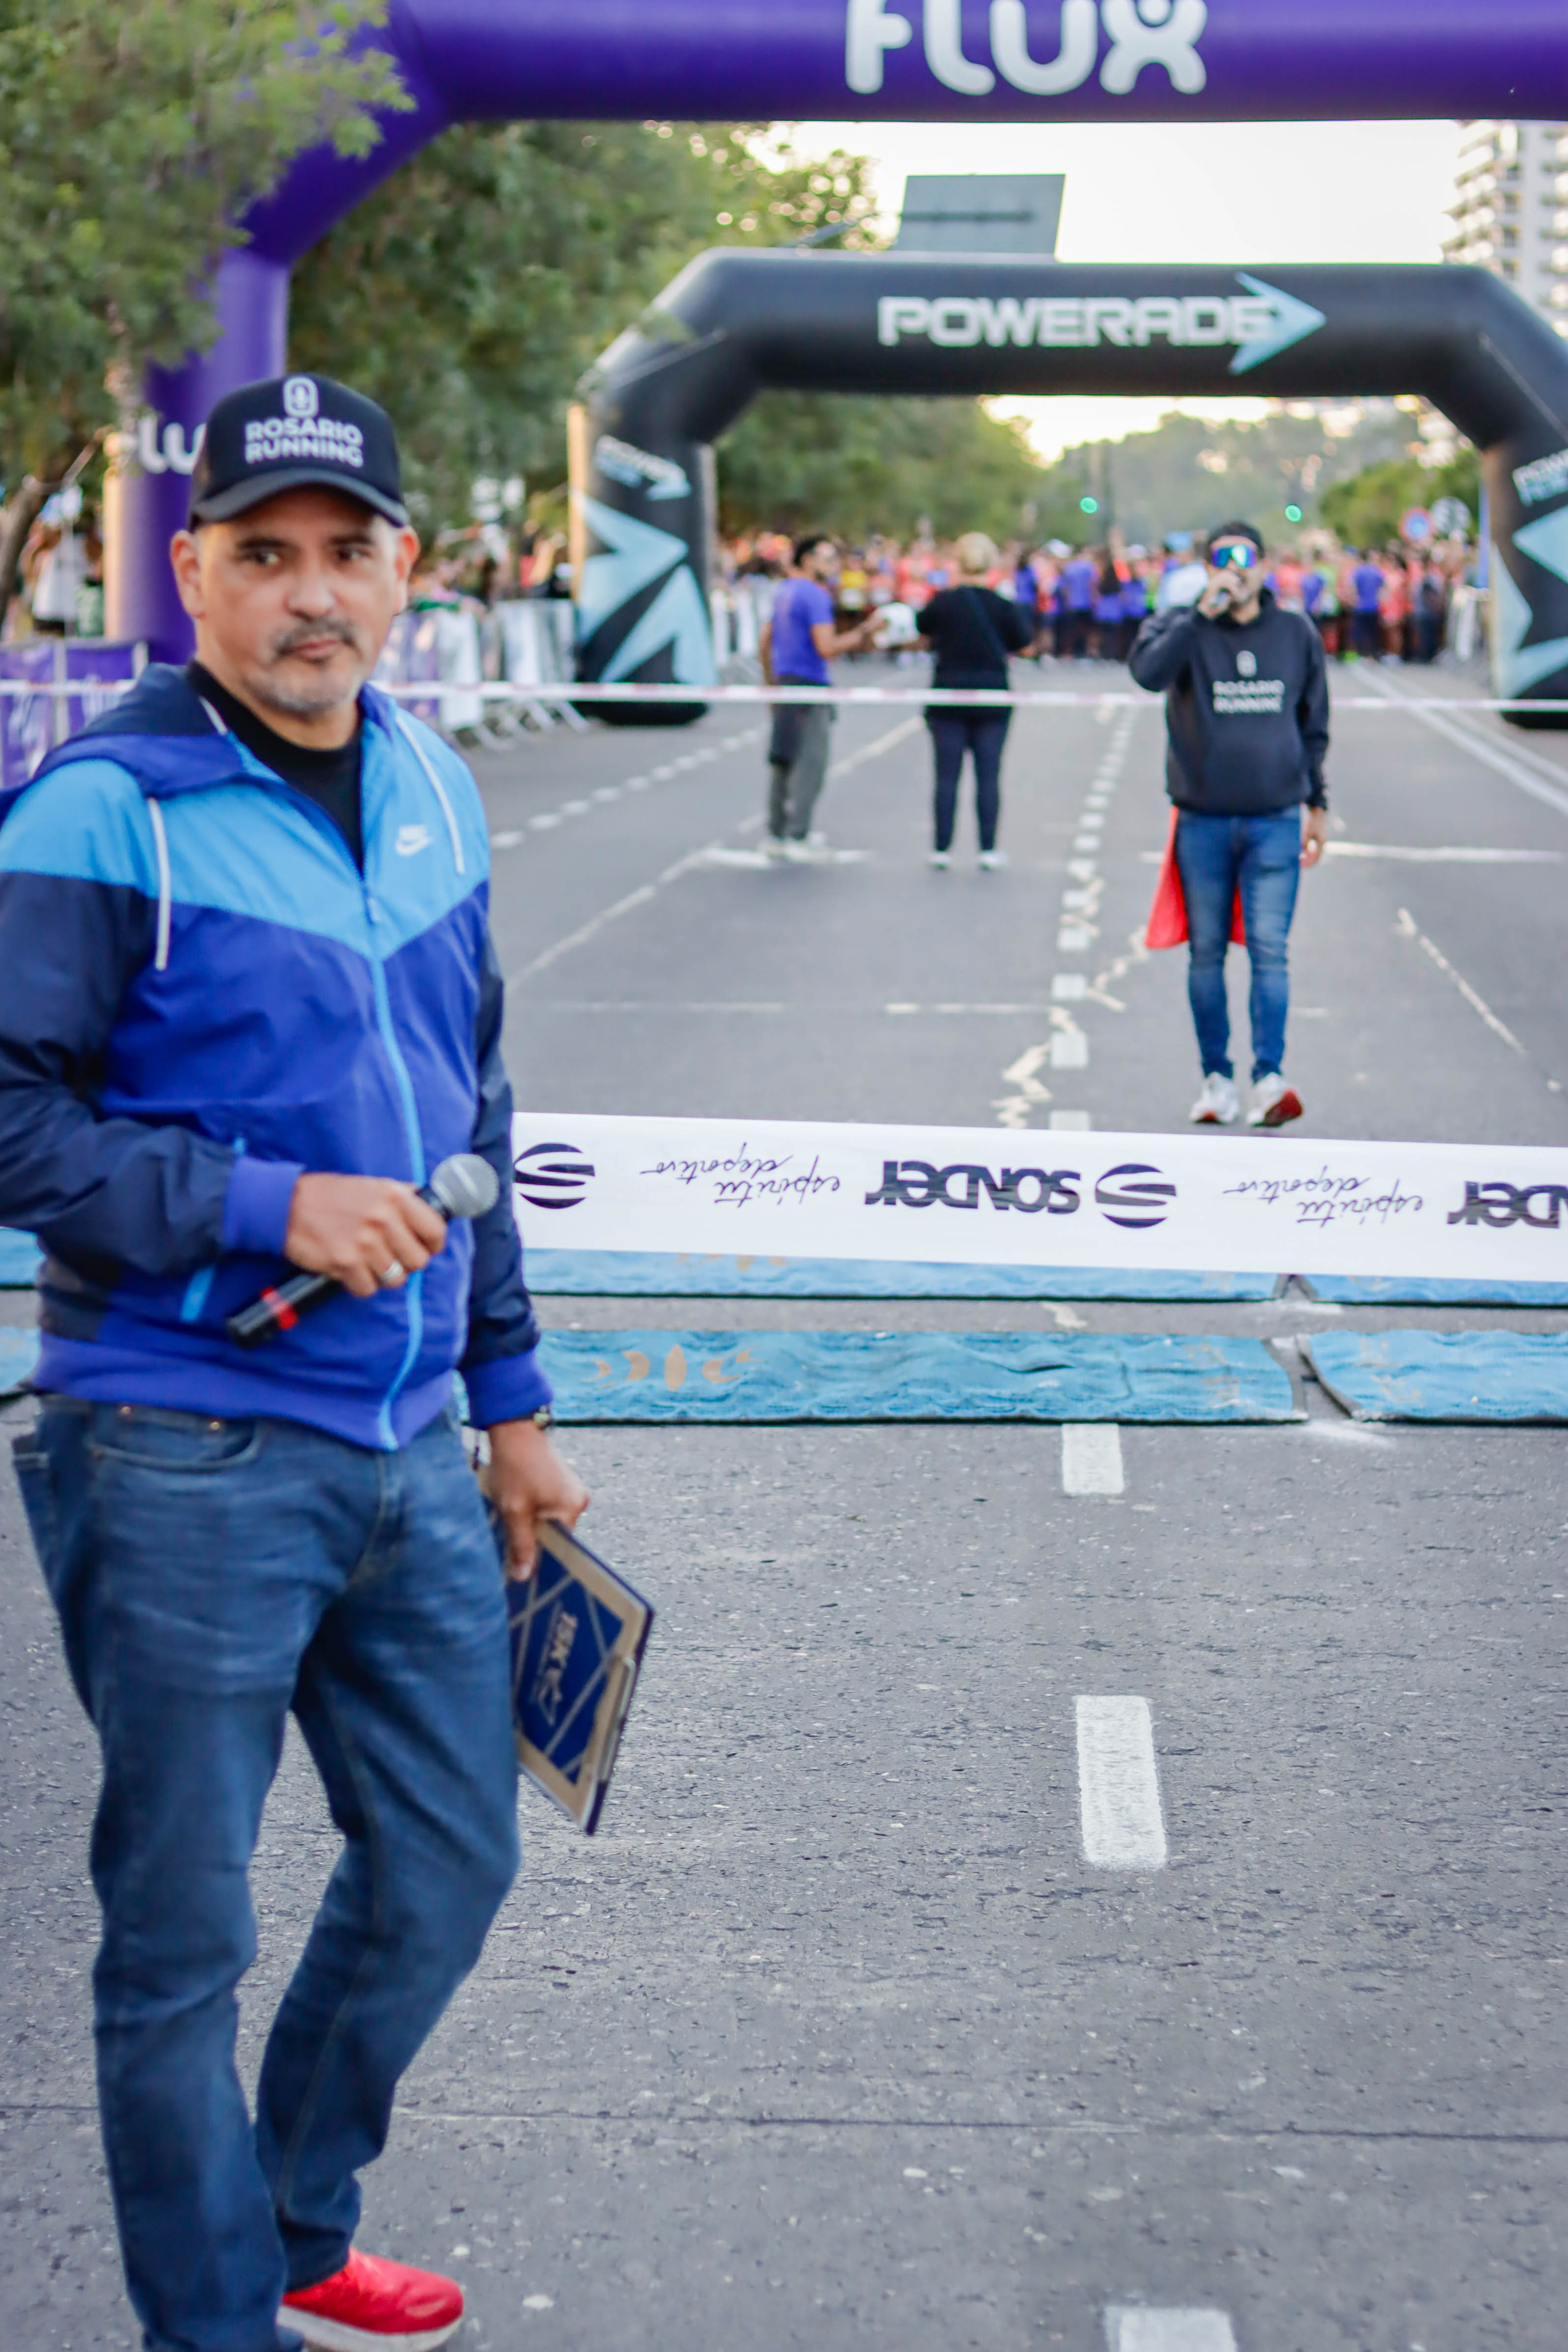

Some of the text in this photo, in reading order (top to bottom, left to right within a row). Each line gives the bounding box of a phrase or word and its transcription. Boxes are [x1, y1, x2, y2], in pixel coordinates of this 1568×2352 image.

[878, 296, 1278, 348] POWERADE
[245, 418, 363, 446] ROSARIO
[245, 438, 364, 468] RUNNING
[640, 1142, 794, 1185] deportivo
[1222, 1165, 1370, 1204] deportivo
